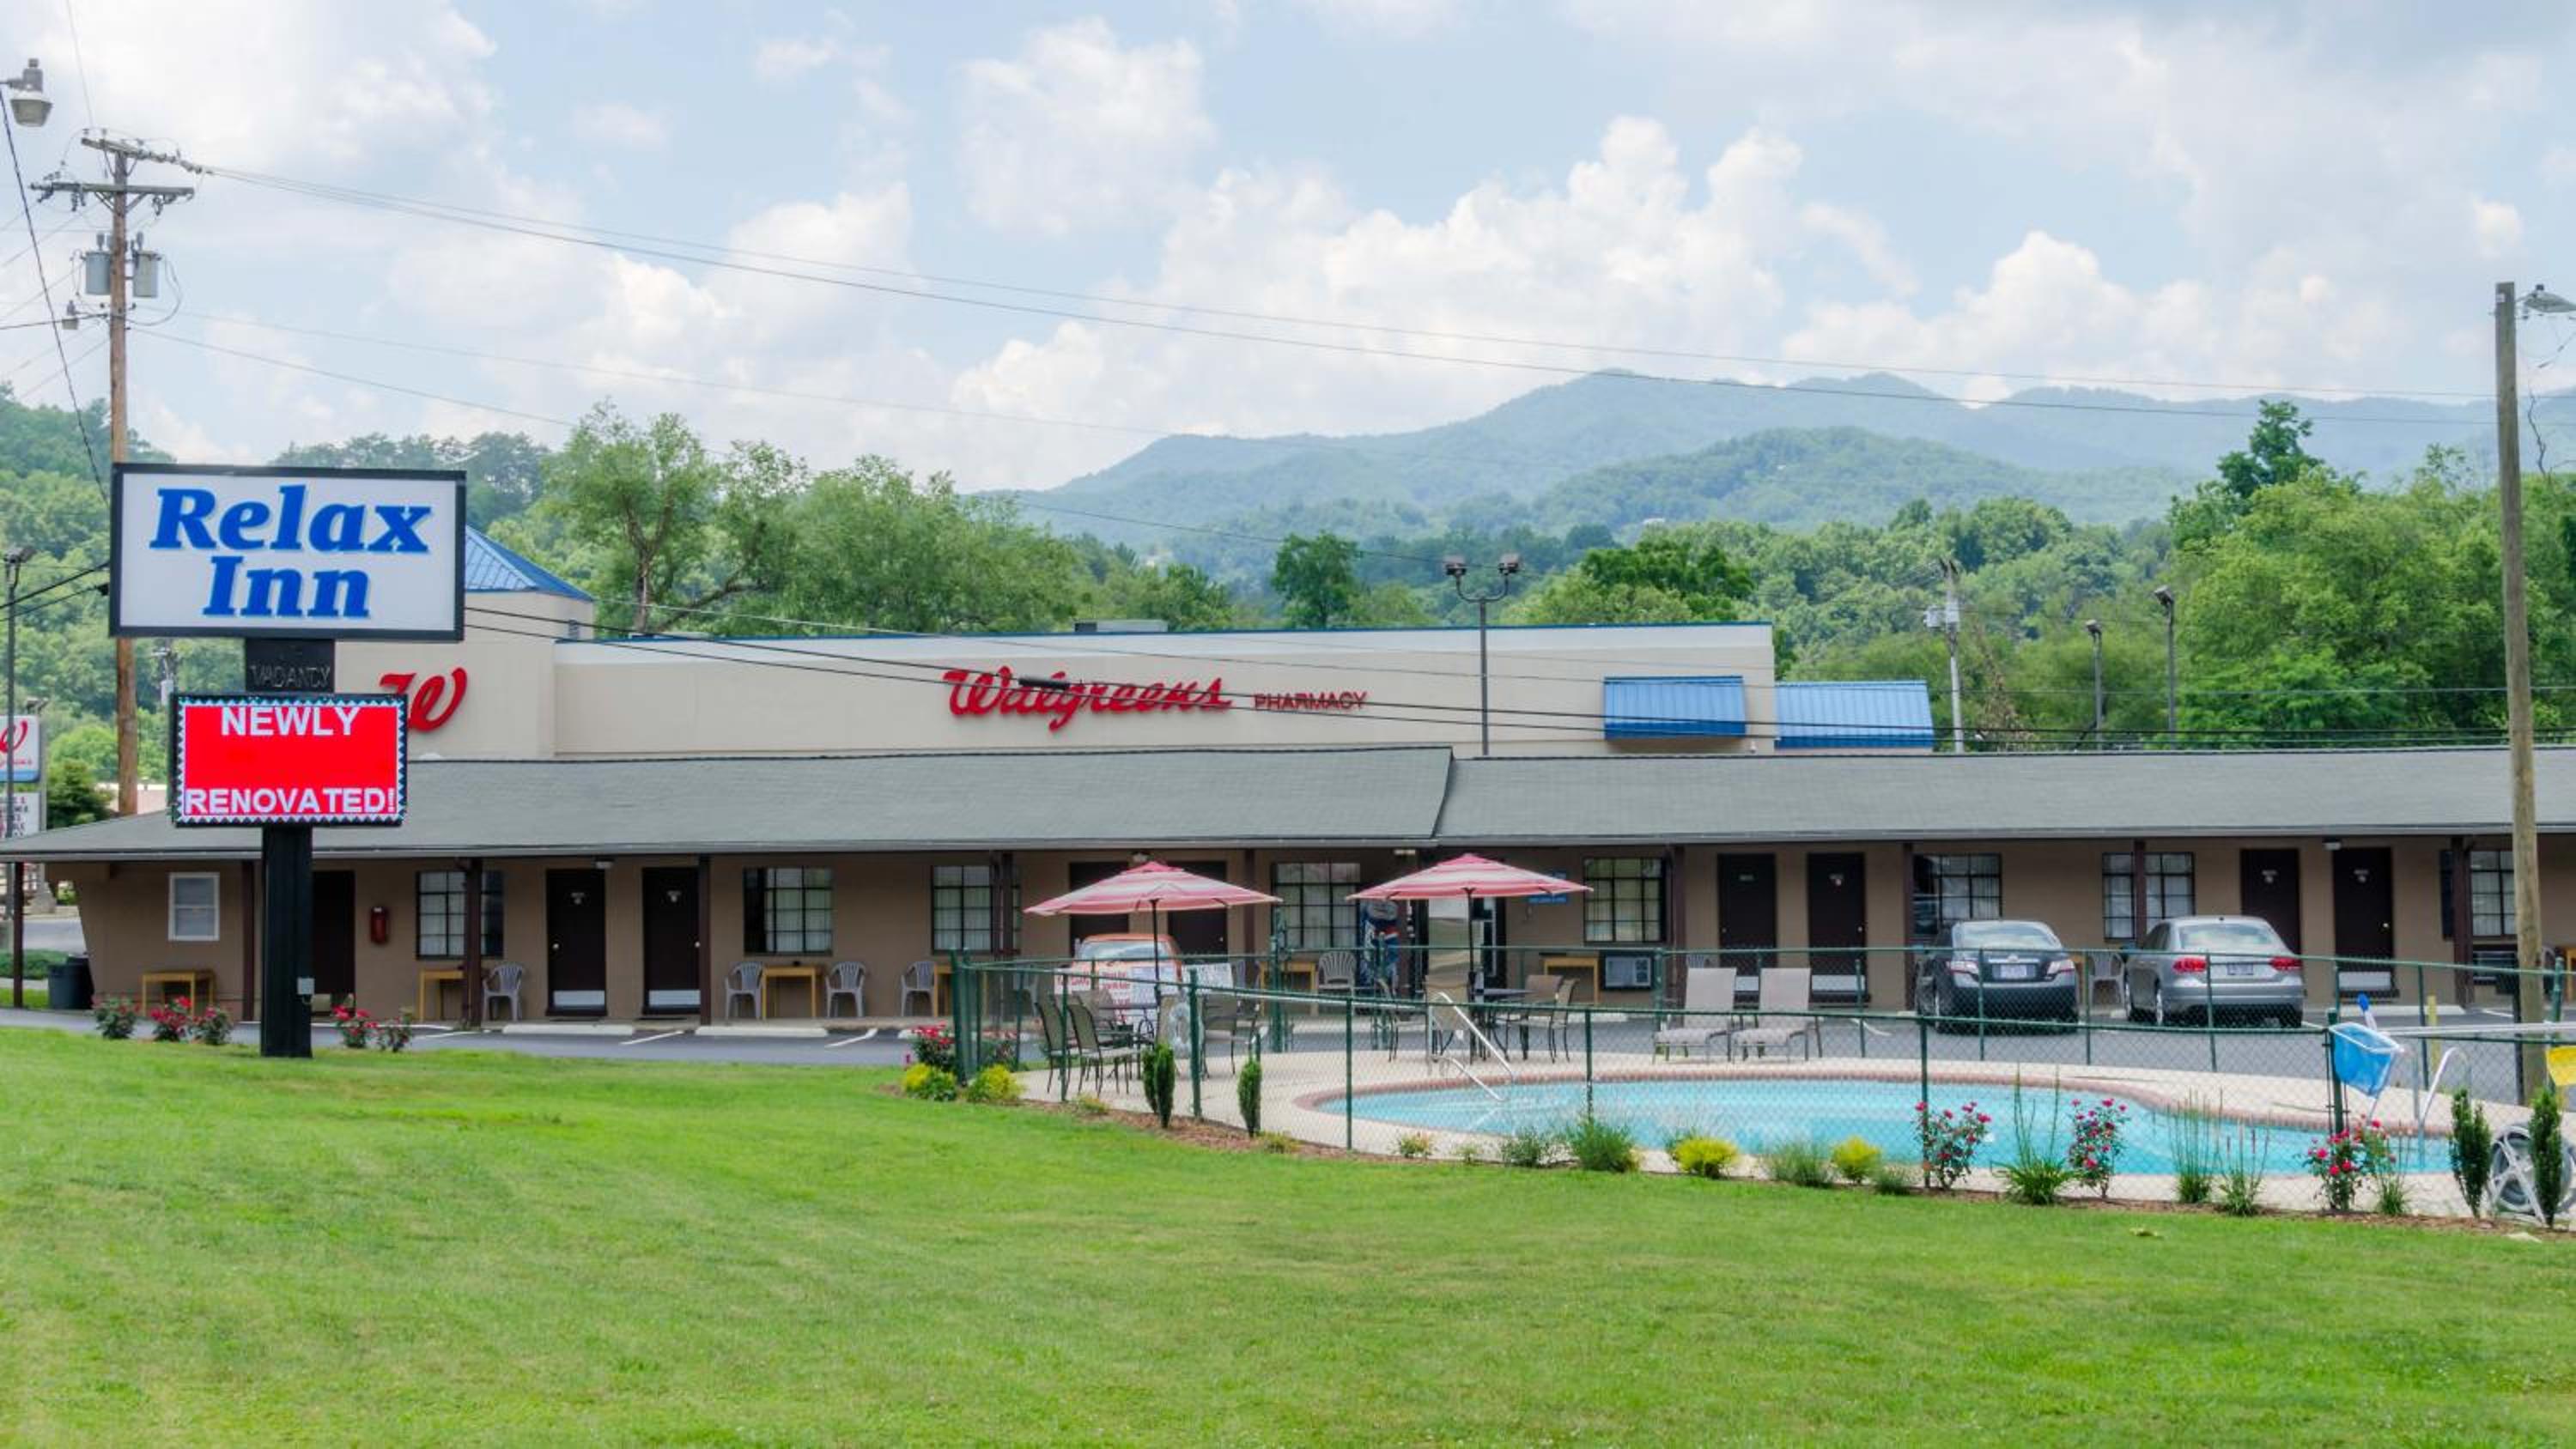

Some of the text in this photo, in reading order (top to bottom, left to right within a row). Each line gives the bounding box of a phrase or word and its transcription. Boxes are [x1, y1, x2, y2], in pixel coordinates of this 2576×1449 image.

[149, 484, 433, 555] Relax
[202, 555, 370, 620] Inn
[221, 706, 361, 737] NEWLY
[943, 665, 1369, 733] Walgreens PHARMACY
[185, 786, 395, 814] RENOVATED!
